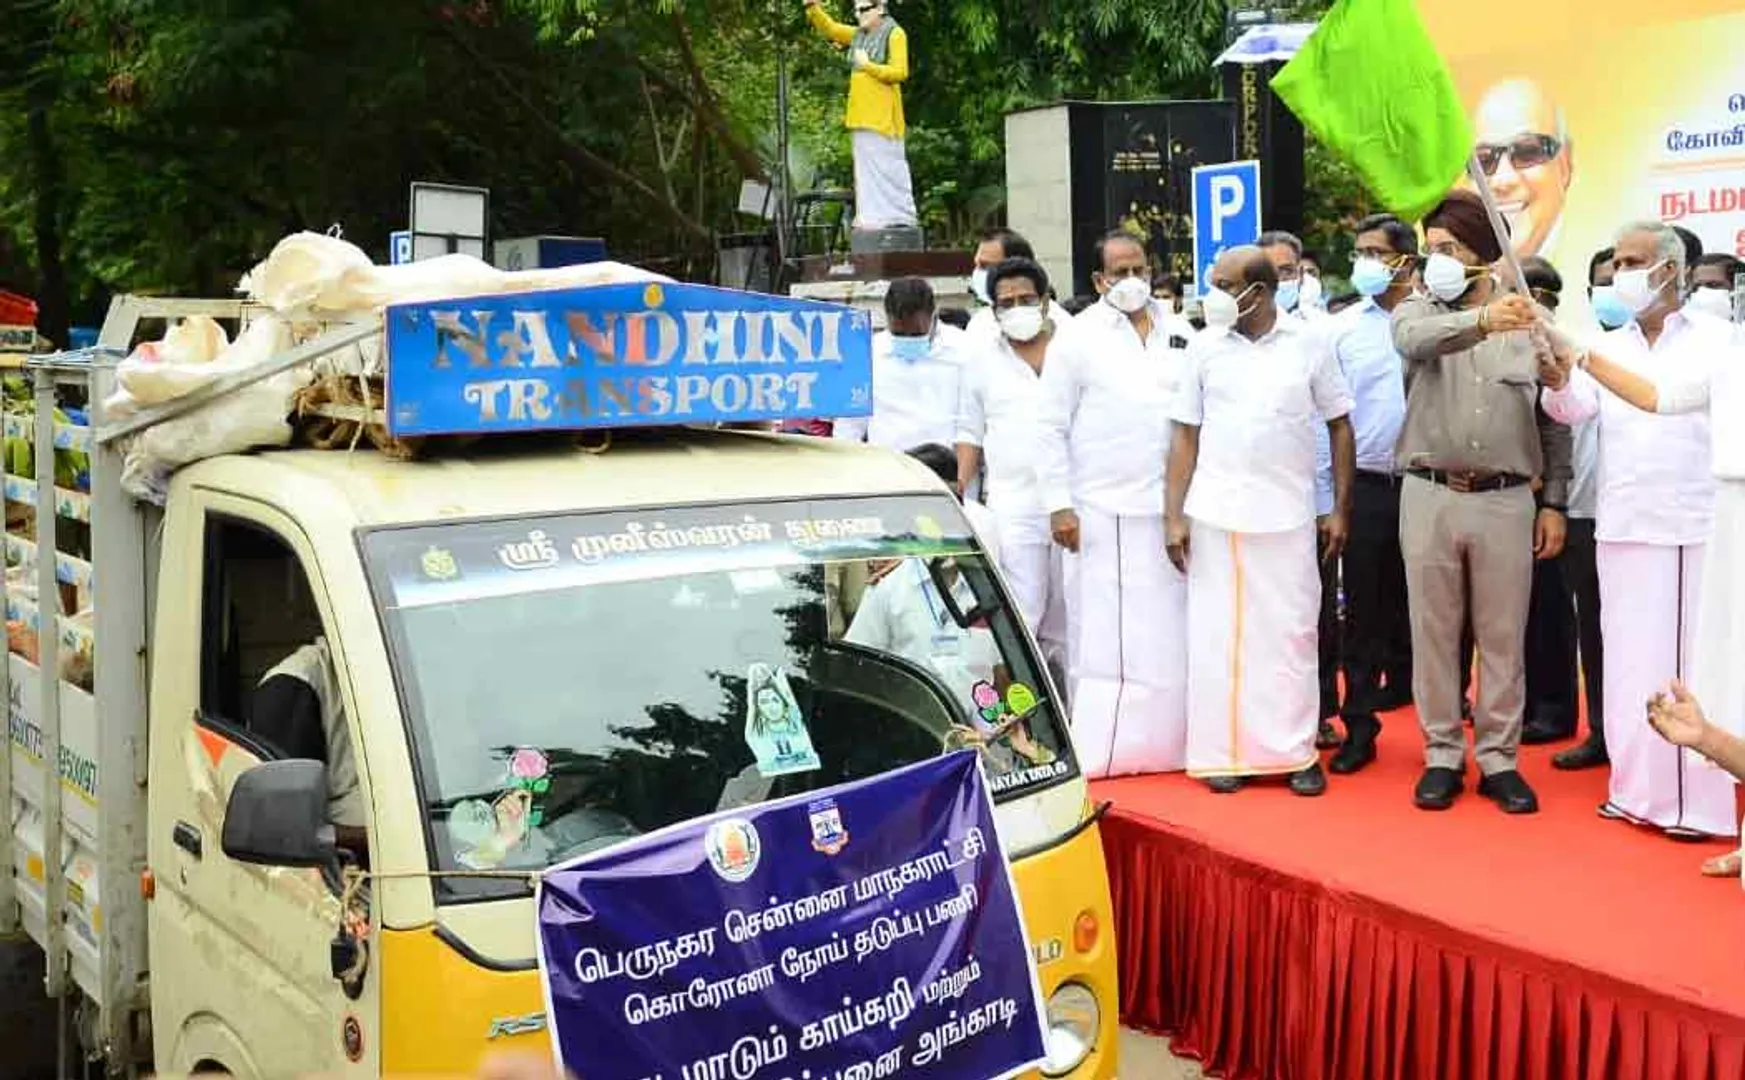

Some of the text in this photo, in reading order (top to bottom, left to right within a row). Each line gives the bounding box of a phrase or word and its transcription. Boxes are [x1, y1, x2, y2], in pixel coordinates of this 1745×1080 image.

[1210, 175, 1245, 241] P
[429, 308, 844, 369] NANDHINI
[463, 370, 820, 421] TRANSPORT
[574, 924, 719, 984] பெருநகர
[724, 884, 848, 943] சென்னை
[780, 929, 849, 983] நோய்
[799, 975, 917, 1052] காய்கறி
[912, 996, 1019, 1067] அங்காடி
